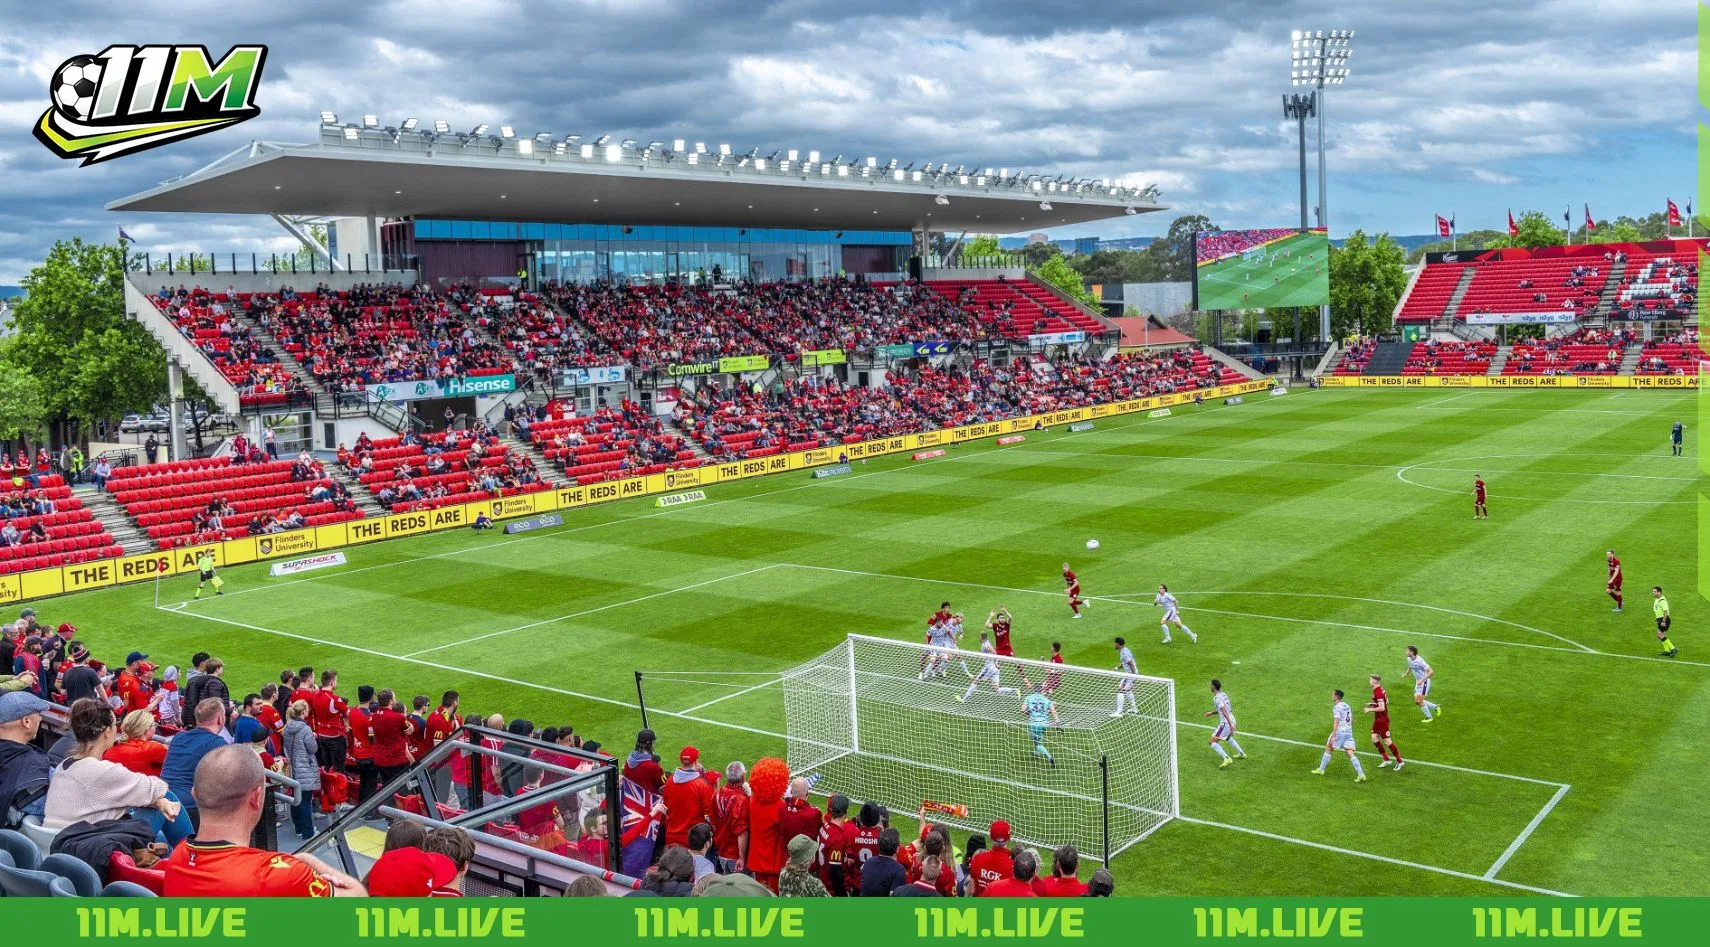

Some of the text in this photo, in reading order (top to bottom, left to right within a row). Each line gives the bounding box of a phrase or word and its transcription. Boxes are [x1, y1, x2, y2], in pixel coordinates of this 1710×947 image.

[450, 379, 511, 394] Hisense
[1043, 415, 1053, 424] THE
[1071, 411, 1080, 420] ARE
[955, 423, 1000, 439] THE REDS ARE
[849, 439, 903, 456] THE REDS ARE
[721, 458, 786, 478] THE REDS ARE
[561, 480, 643, 504] THE REDS ARE
[504, 498, 527, 508] Flinders
[504, 503, 533, 515] University
[353, 509, 461, 538] THE REDS ARE
[275, 532, 305, 544] Flinders
[275, 540, 314, 552] University
[71, 565, 109, 586] THE
[123, 556, 170, 577] REDS
[980, 868, 1003, 881] RGK
